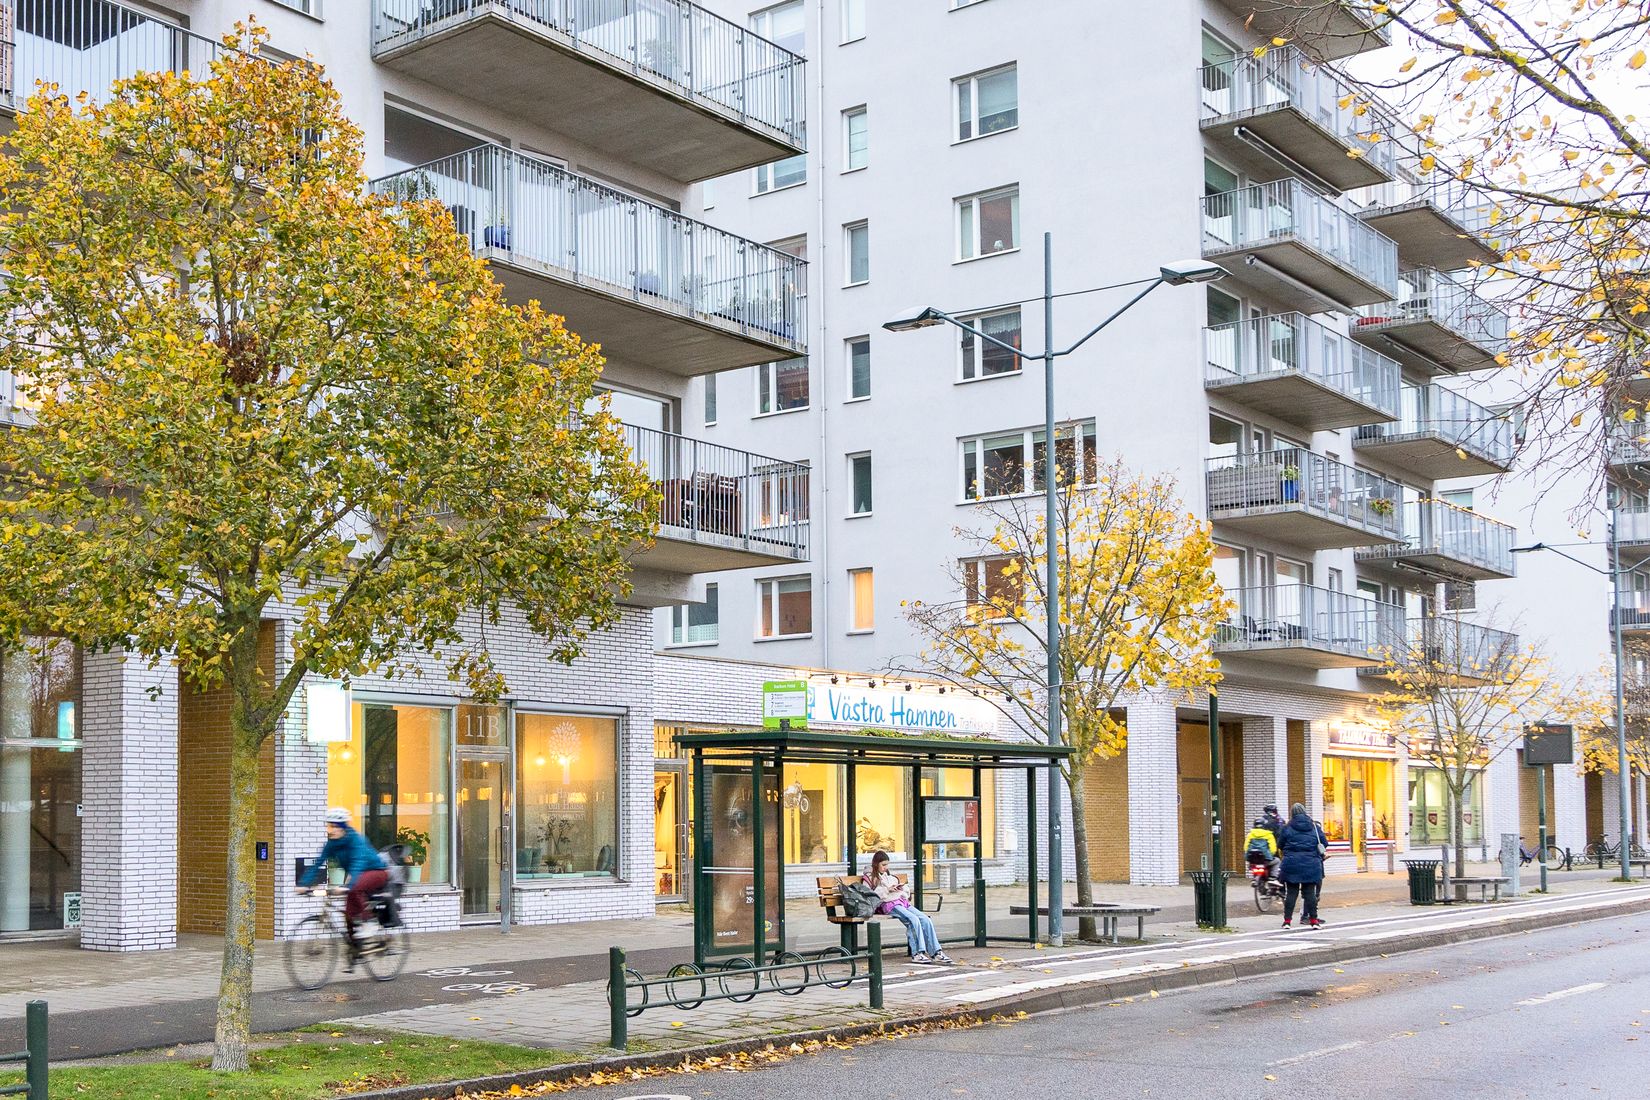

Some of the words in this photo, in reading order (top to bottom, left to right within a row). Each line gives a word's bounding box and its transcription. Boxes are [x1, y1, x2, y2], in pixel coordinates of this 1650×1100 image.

[828, 688, 885, 723] Västra
[890, 696, 957, 728] Hamnen
[464, 714, 499, 738] 11B
